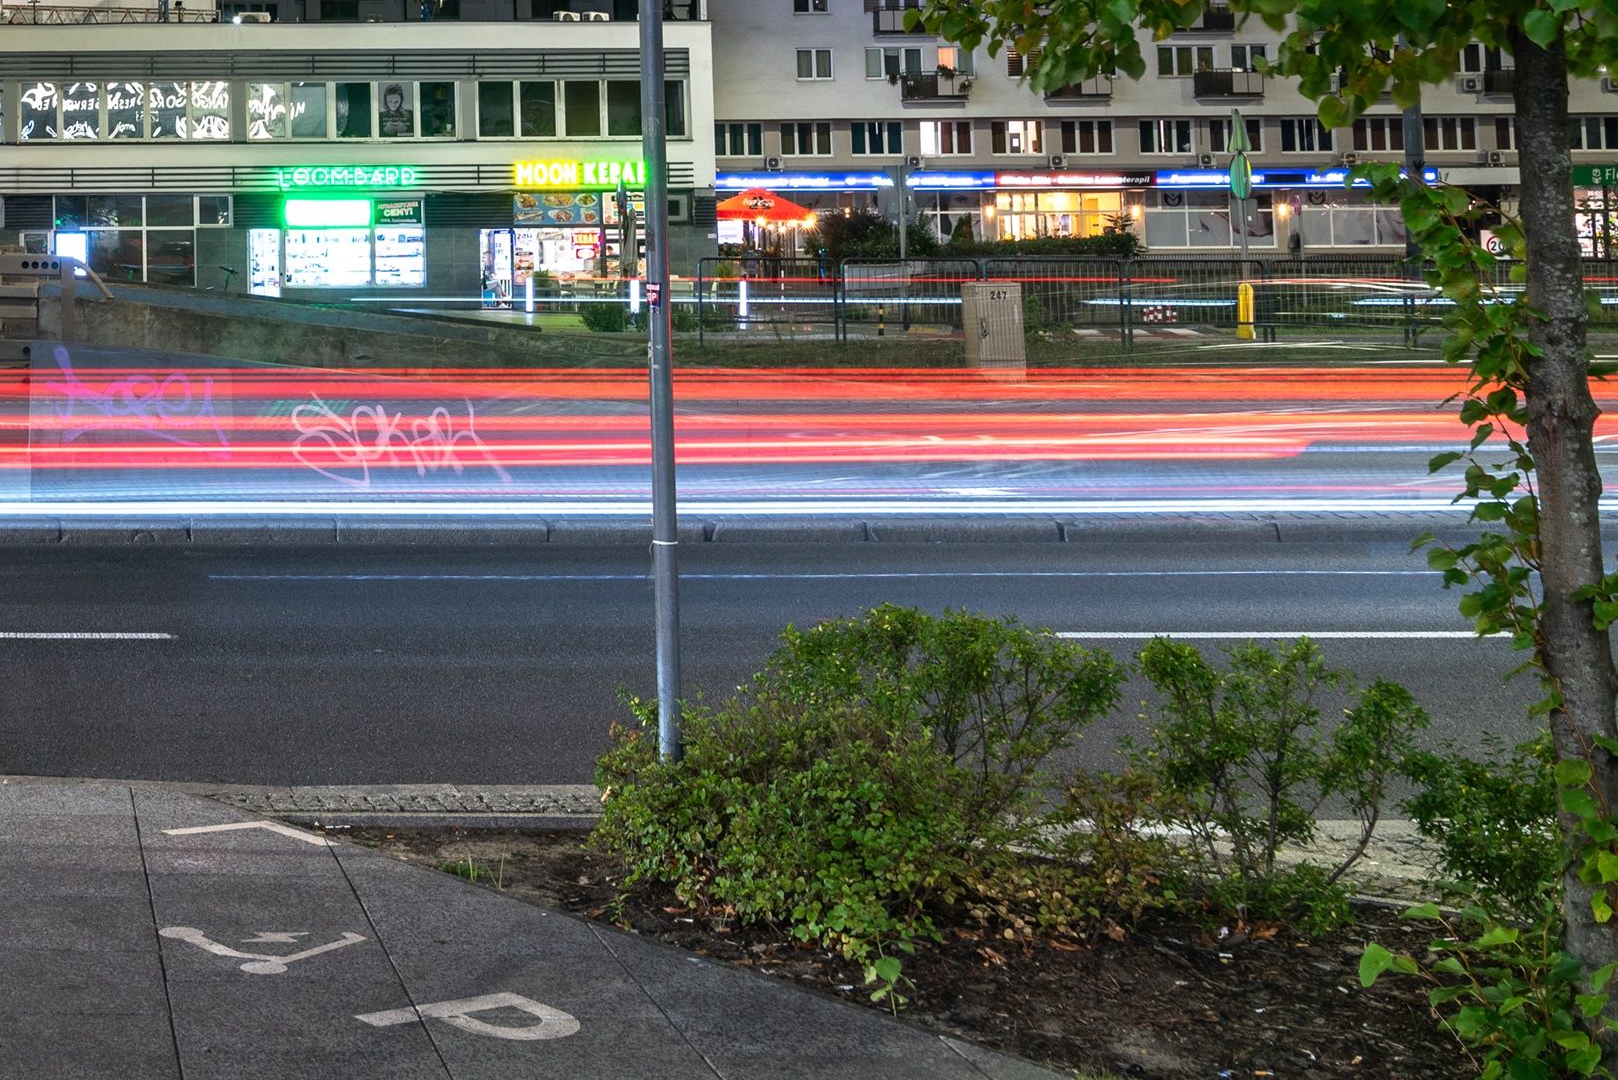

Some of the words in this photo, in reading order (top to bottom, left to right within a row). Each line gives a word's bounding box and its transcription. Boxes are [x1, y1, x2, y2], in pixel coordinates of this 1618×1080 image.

[278, 167, 416, 188] LOOMBARD
[516, 162, 579, 185] MOON
[573, 234, 599, 245] KEBAB
[1490, 240, 1506, 253] 20
[990, 291, 1007, 300] 247
[355, 992, 581, 1041] P
